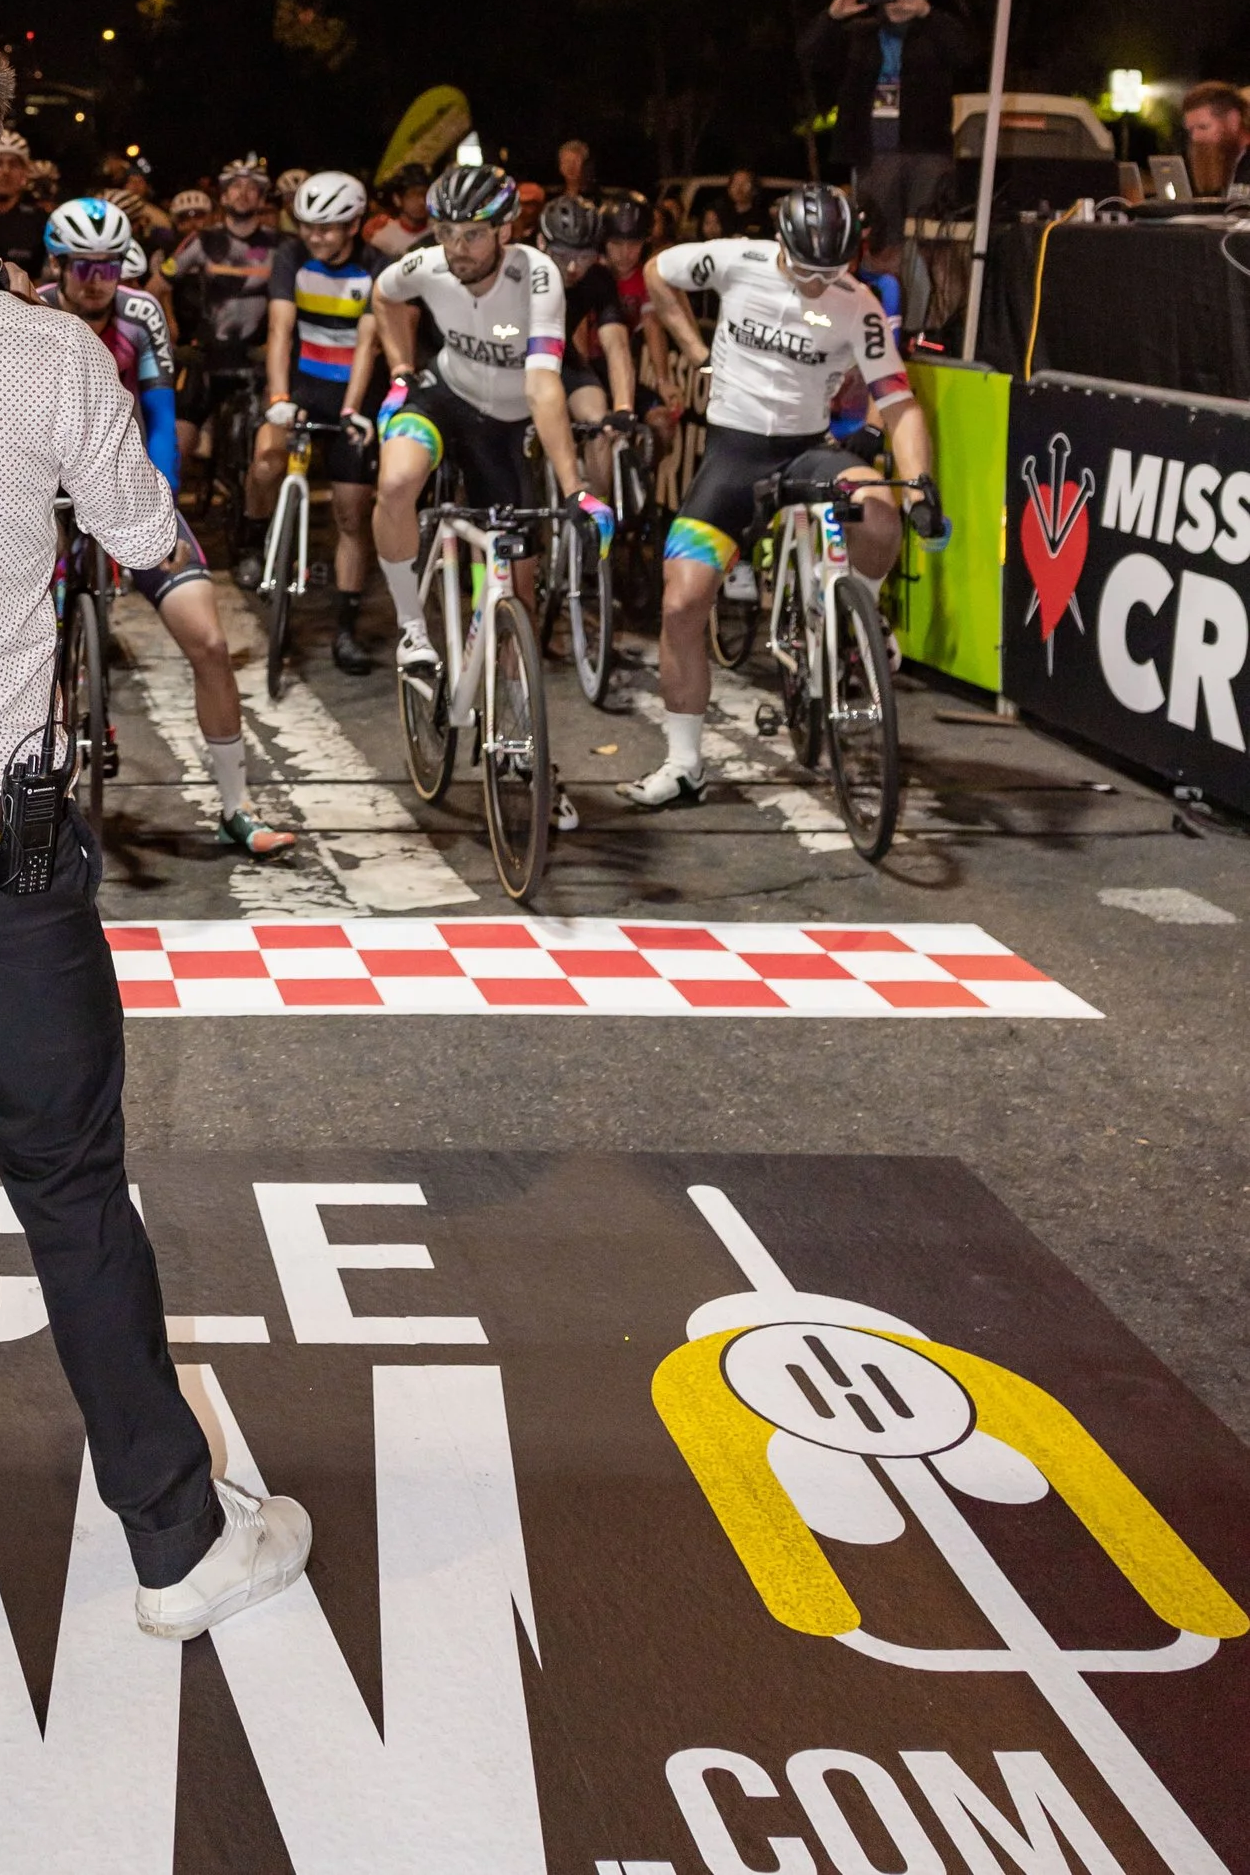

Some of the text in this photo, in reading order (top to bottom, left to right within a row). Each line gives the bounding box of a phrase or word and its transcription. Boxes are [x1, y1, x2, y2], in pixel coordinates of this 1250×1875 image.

[124, 297, 174, 374] JAKROO
[448, 329, 515, 364] STATE
[742, 318, 814, 353] STATE
[1101, 448, 1250, 565] MISS
[1097, 553, 1249, 753] CR
